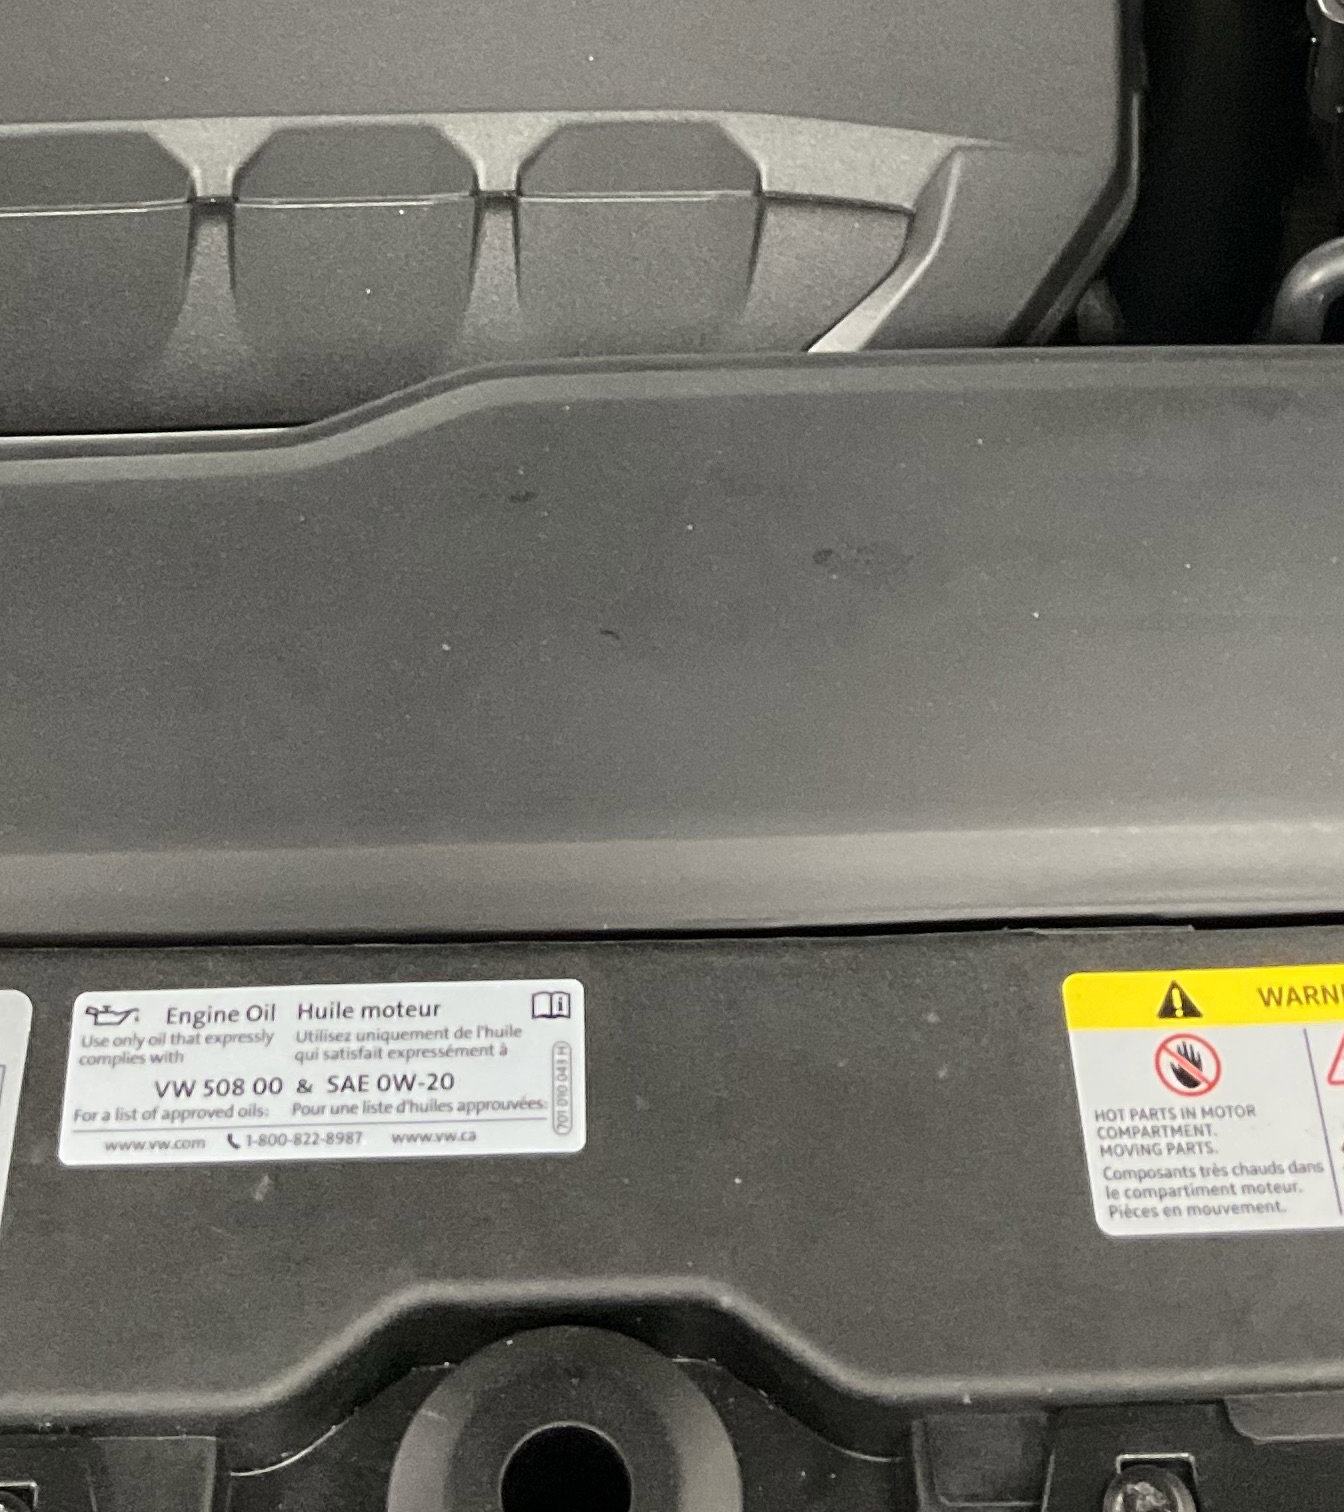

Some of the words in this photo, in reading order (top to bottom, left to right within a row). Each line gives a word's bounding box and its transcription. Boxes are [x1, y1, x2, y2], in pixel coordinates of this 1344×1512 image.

[166, 1005, 239, 1030] Engine
[246, 1003, 276, 1022] Oil
[297, 1002, 354, 1020] Huile
[361, 1001, 441, 1019] moteur
[81, 1035, 107, 1048] Use
[113, 1035, 143, 1051] only
[148, 1032, 167, 1045] oil
[170, 1031, 201, 1044] that
[205, 1029, 275, 1047] expressly
[296, 1029, 352, 1044] Utilisez
[356, 1028, 449, 1047] uniquement
[454, 1026, 473, 1039] de
[476, 1024, 523, 1039] l'huile
[79, 1052, 146, 1068] complies
[150, 1050, 184, 1063] with
[295, 1047, 319, 1064] qui
[323, 1044, 383, 1060] satisfait
[387, 1043, 494, 1063] expressément
[499, 1044, 508, 1056] à
[155, 1079, 197, 1099] VW
[204, 1079, 245, 1097] 508
[253, 1077, 283, 1095] 00
[296, 1079, 313, 1094] &
[327, 1074, 370, 1093] SAE
[376, 1072, 455, 1092] 0W-20
[73, 1108, 98, 1122] For
[101, 1111, 111, 1121] a
[115, 1107, 138, 1121] list
[141, 1106, 157, 1120] of
[161, 1103, 234, 1124] approved
[237, 1104, 269, 1118] oils:
[292, 1102, 326, 1116] Pour
[330, 1103, 358, 1115] une
[362, 1100, 392, 1114] liste
[396, 1099, 453, 1114] d'huiles
[457, 1096, 548, 1116] approuvées:
[1094, 1108, 1126, 1122] HOT
[1130, 1107, 1177, 1121] PARTS
[1181, 1106, 1197, 1119] IN
[1201, 1105, 1256, 1119] MOTOR
[105, 1138, 206, 1151] www.vw.com
[392, 1130, 477, 1143] www.vw.ca
[1097, 1124, 1218, 1139] COMPARTMENT.
[1100, 1143, 1163, 1157] MOVING
[1166, 1141, 1218, 1155] PARTS.
[1103, 1165, 1196, 1182] Composants
[1200, 1163, 1228, 1177] très
[1232, 1161, 1284, 1176] chauds
[1288, 1160, 1324, 1174] dans
[1124, 1183, 1238, 1201] compartiment
[1241, 1181, 1303, 1194] moteur.
[1109, 1203, 1159, 1219] Pièces
[1163, 1205, 1182, 1217] en
[1187, 1201, 1287, 1217] mouvement.
